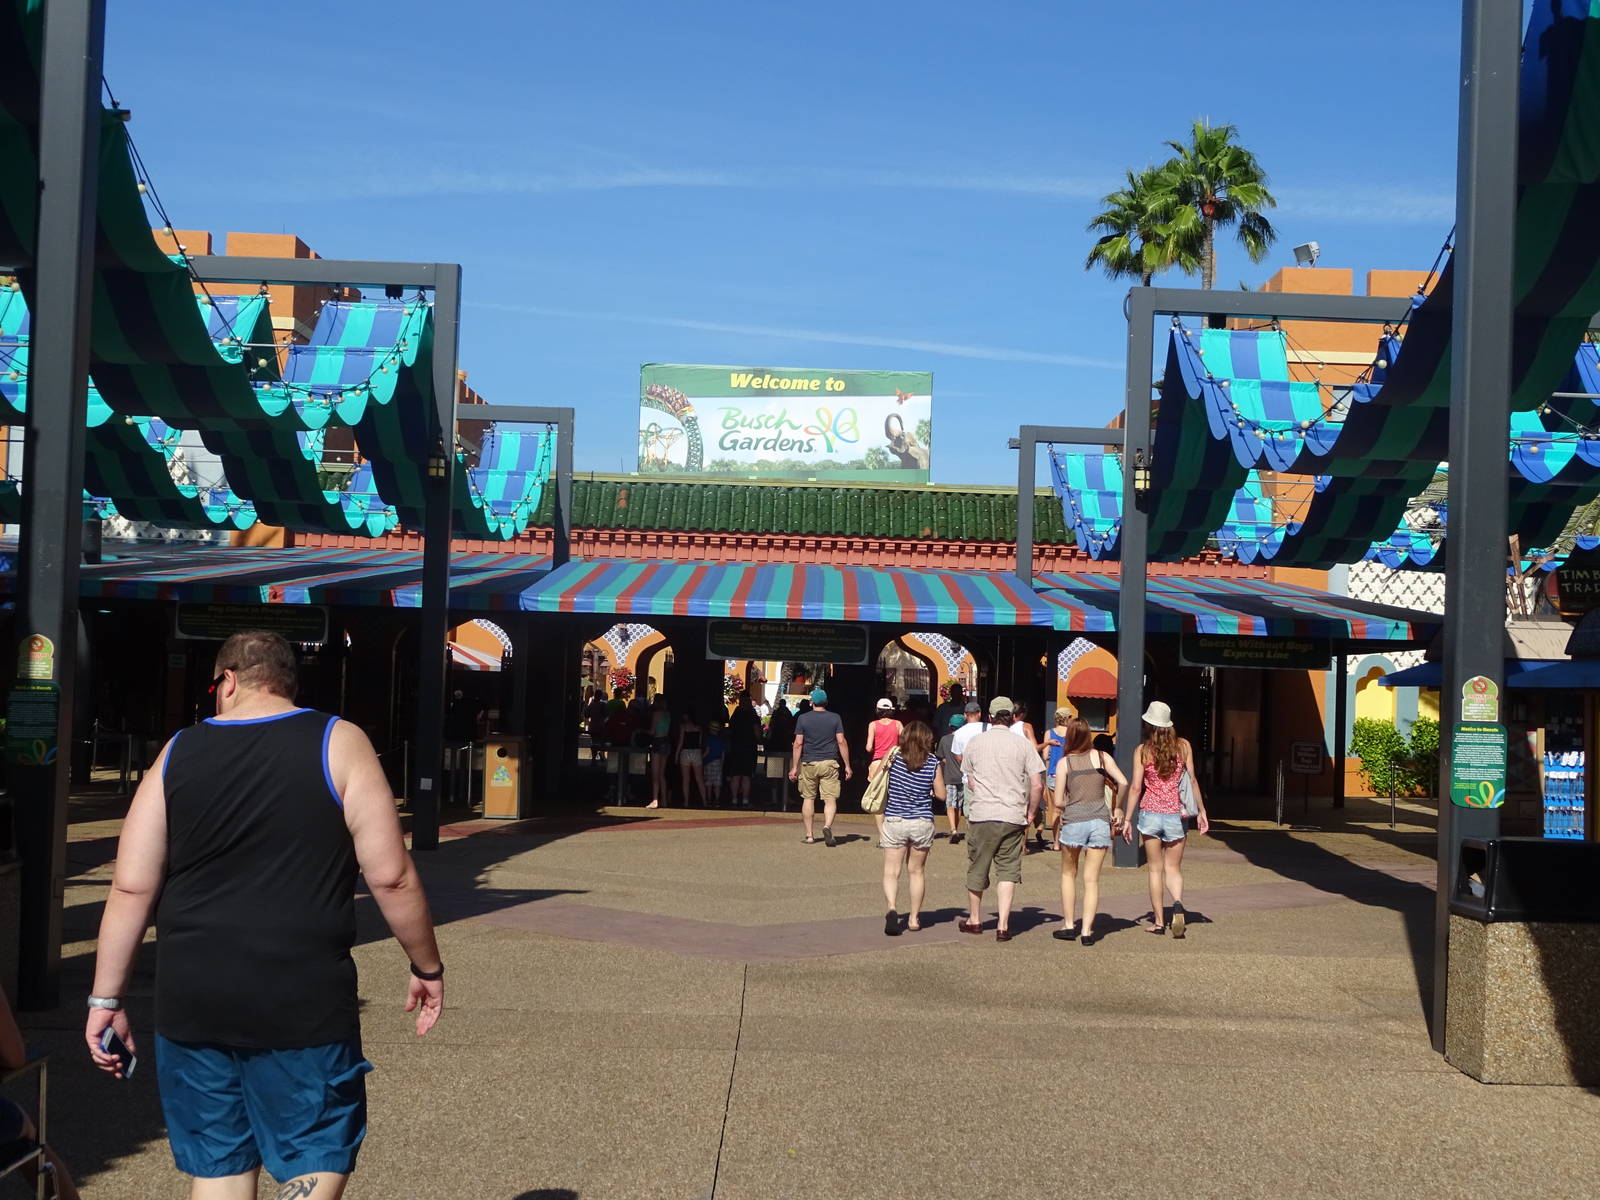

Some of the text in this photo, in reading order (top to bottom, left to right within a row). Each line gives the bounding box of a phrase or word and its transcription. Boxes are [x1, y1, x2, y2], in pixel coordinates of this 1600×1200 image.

[729, 372, 846, 392] Welcome to
[717, 406, 803, 430] Busch
[718, 430, 814, 453] Gardens
[1222, 649, 1265, 659] Express
